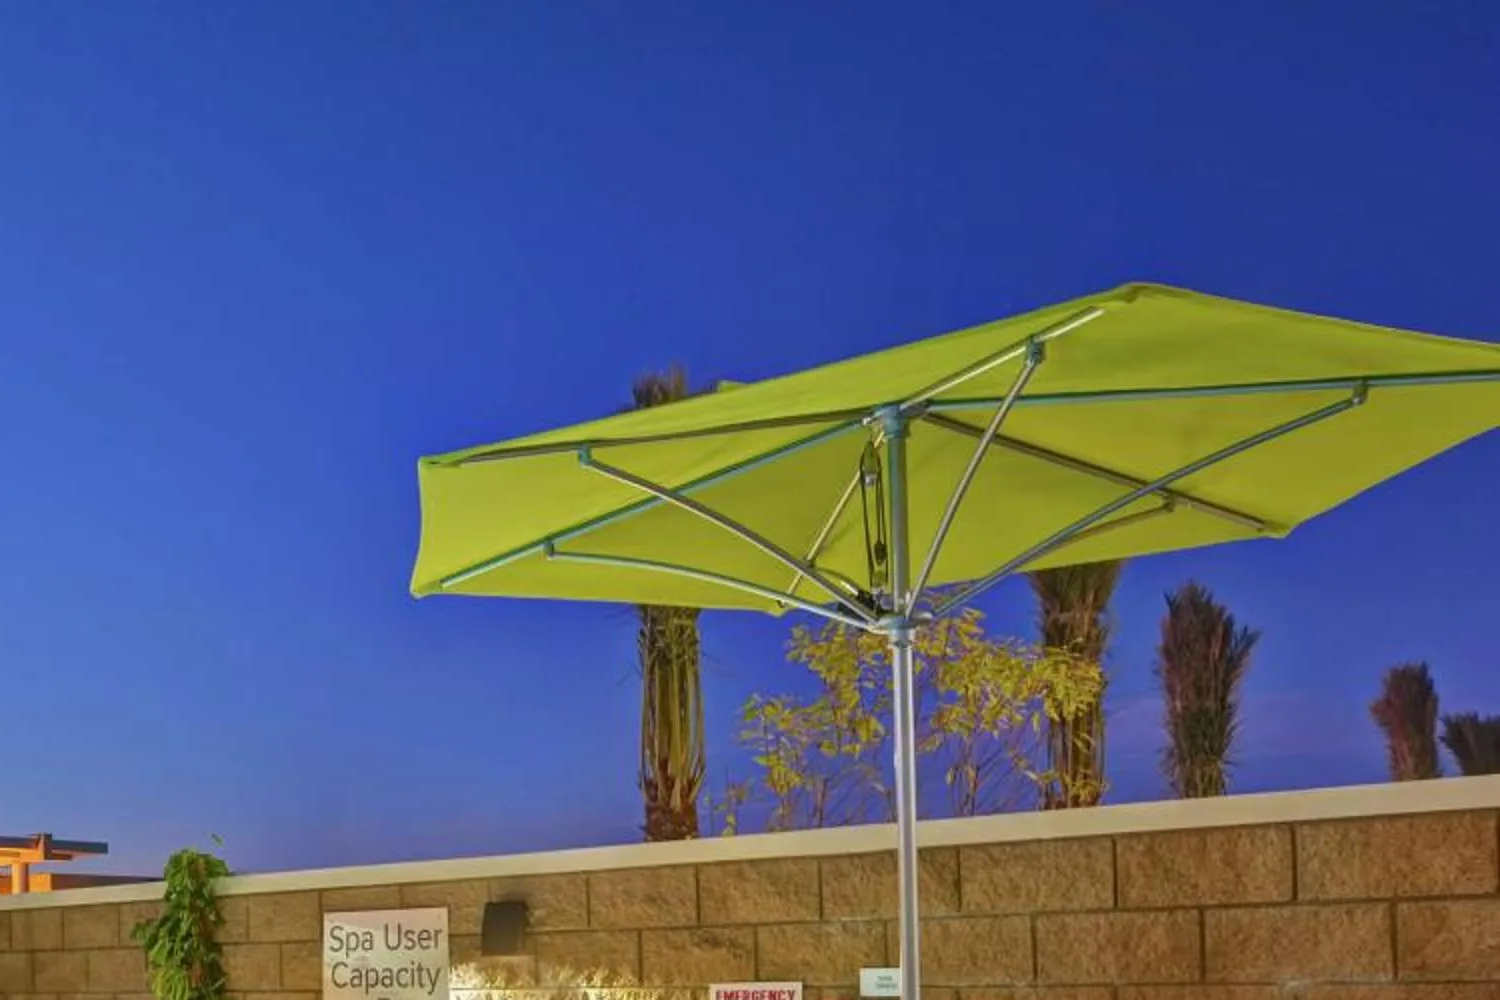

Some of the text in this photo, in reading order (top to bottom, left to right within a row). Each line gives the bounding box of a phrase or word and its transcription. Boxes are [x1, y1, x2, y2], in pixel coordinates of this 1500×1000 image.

[329, 923, 443, 958] Spa User
[331, 961, 441, 996] Capacity
